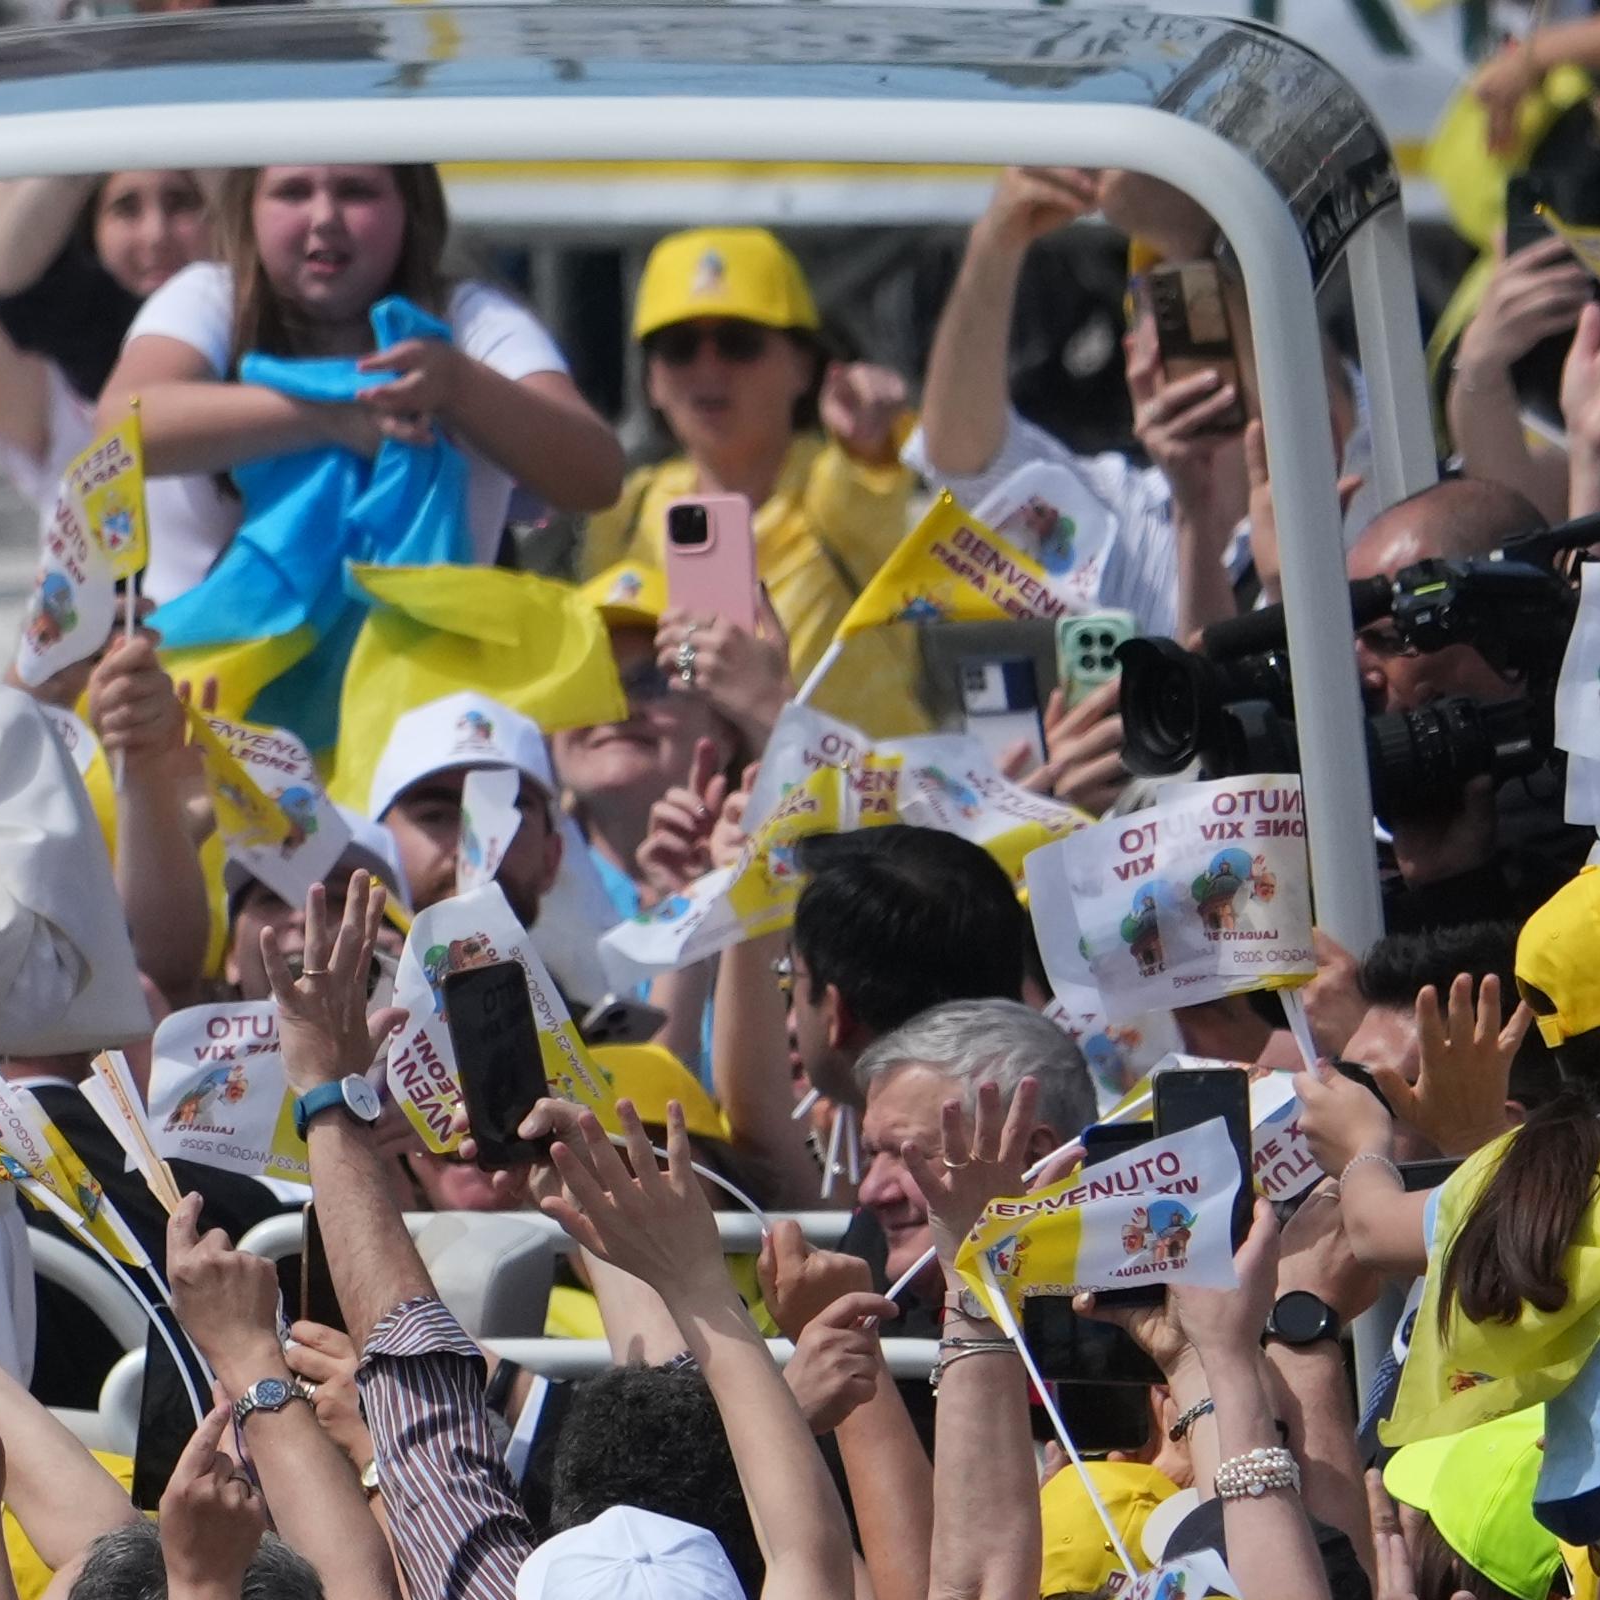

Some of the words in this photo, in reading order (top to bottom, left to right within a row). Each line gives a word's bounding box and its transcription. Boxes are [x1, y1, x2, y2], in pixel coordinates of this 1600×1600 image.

[8, 1116, 44, 1169] MAGGIO
[988, 1151, 1180, 1217] ENVENUTO
[1156, 1176, 1199, 1195] XIV
[1109, 1261, 1168, 1277] AUDATO
